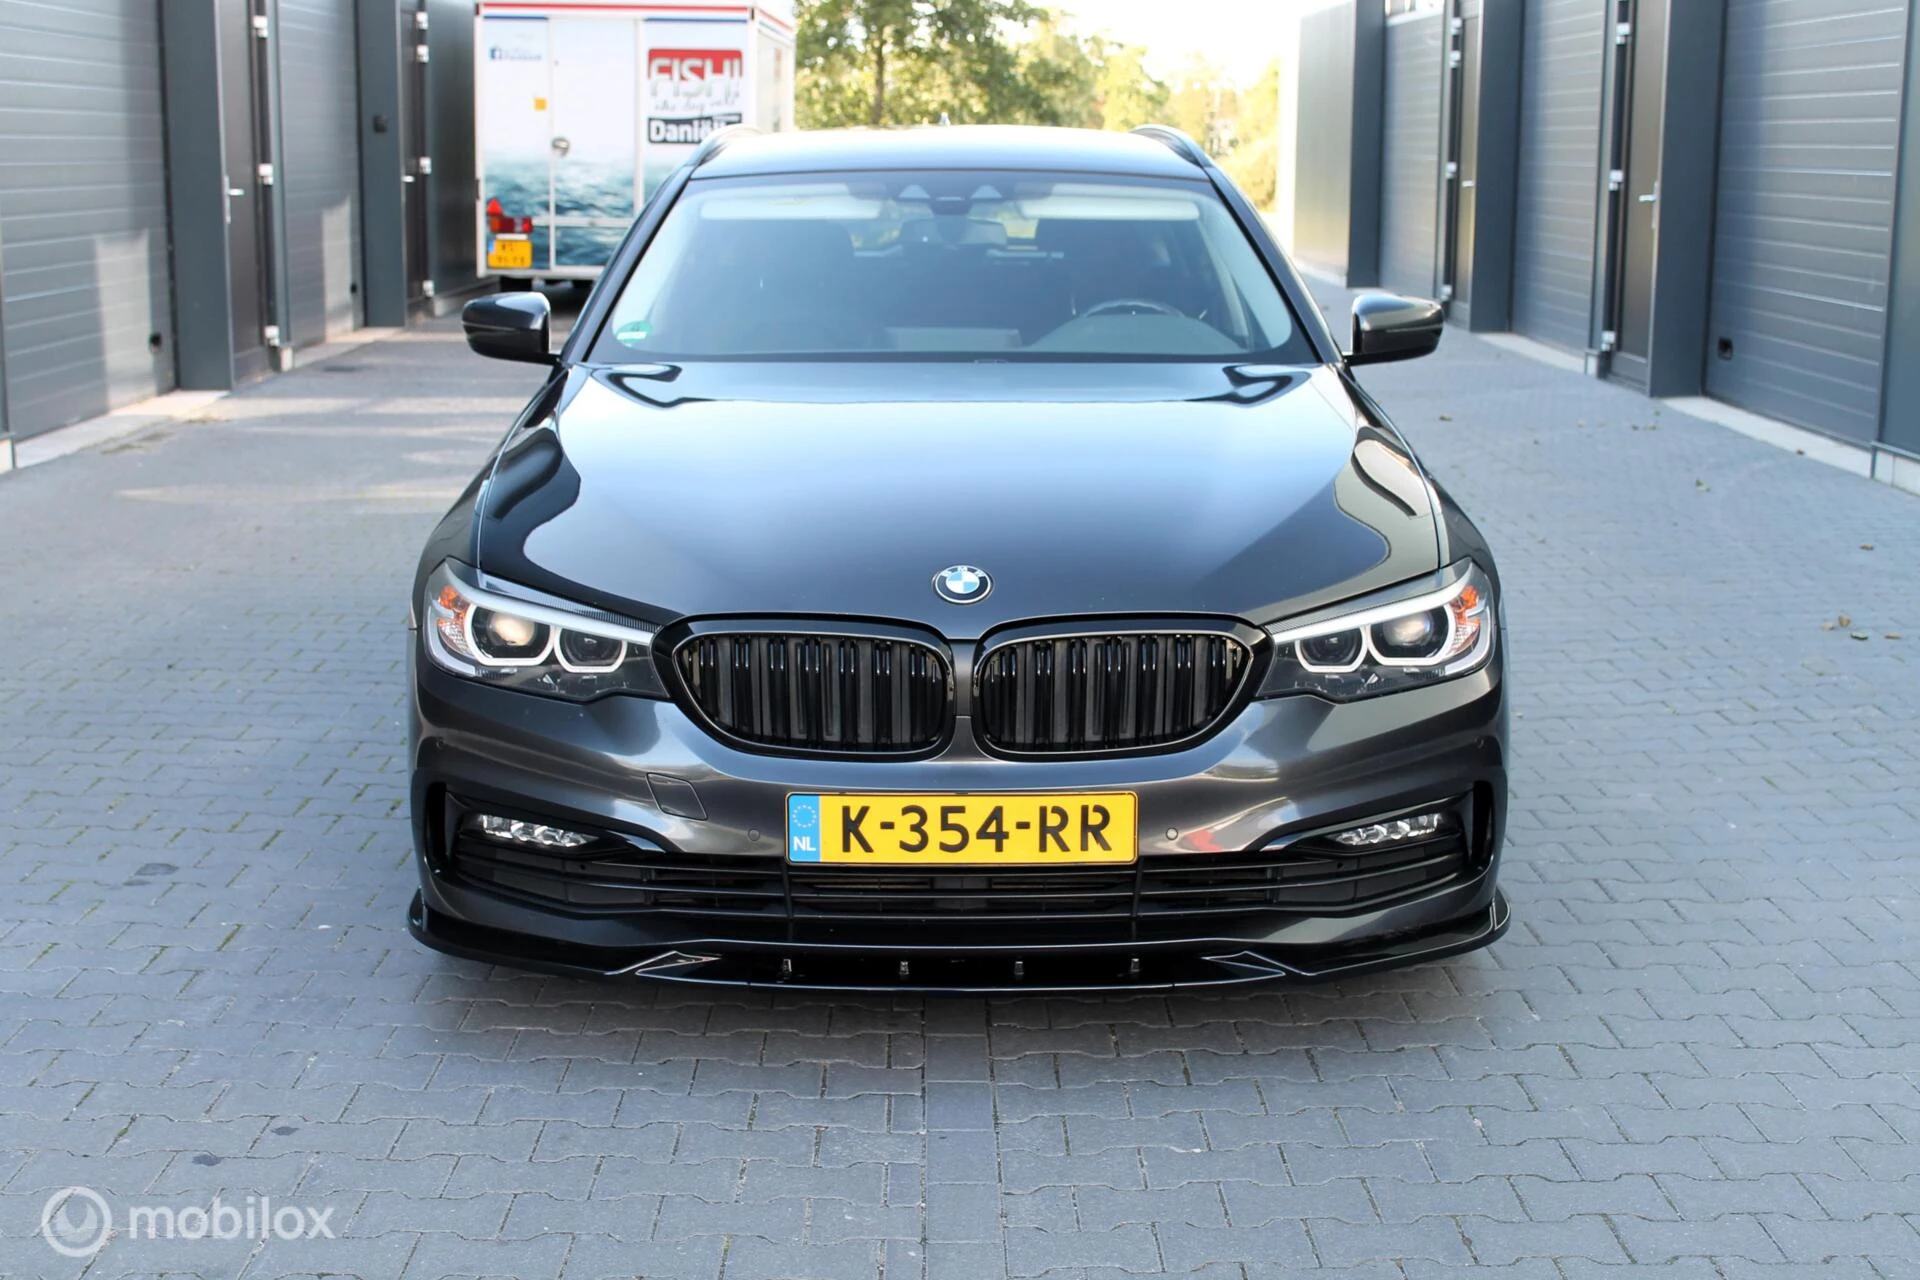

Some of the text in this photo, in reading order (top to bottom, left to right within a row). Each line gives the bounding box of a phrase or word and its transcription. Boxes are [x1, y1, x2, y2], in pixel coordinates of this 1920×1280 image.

[940, 566, 986, 578] BMW
[841, 804, 1112, 853] K-354-RR
[793, 836, 817, 852] NL
